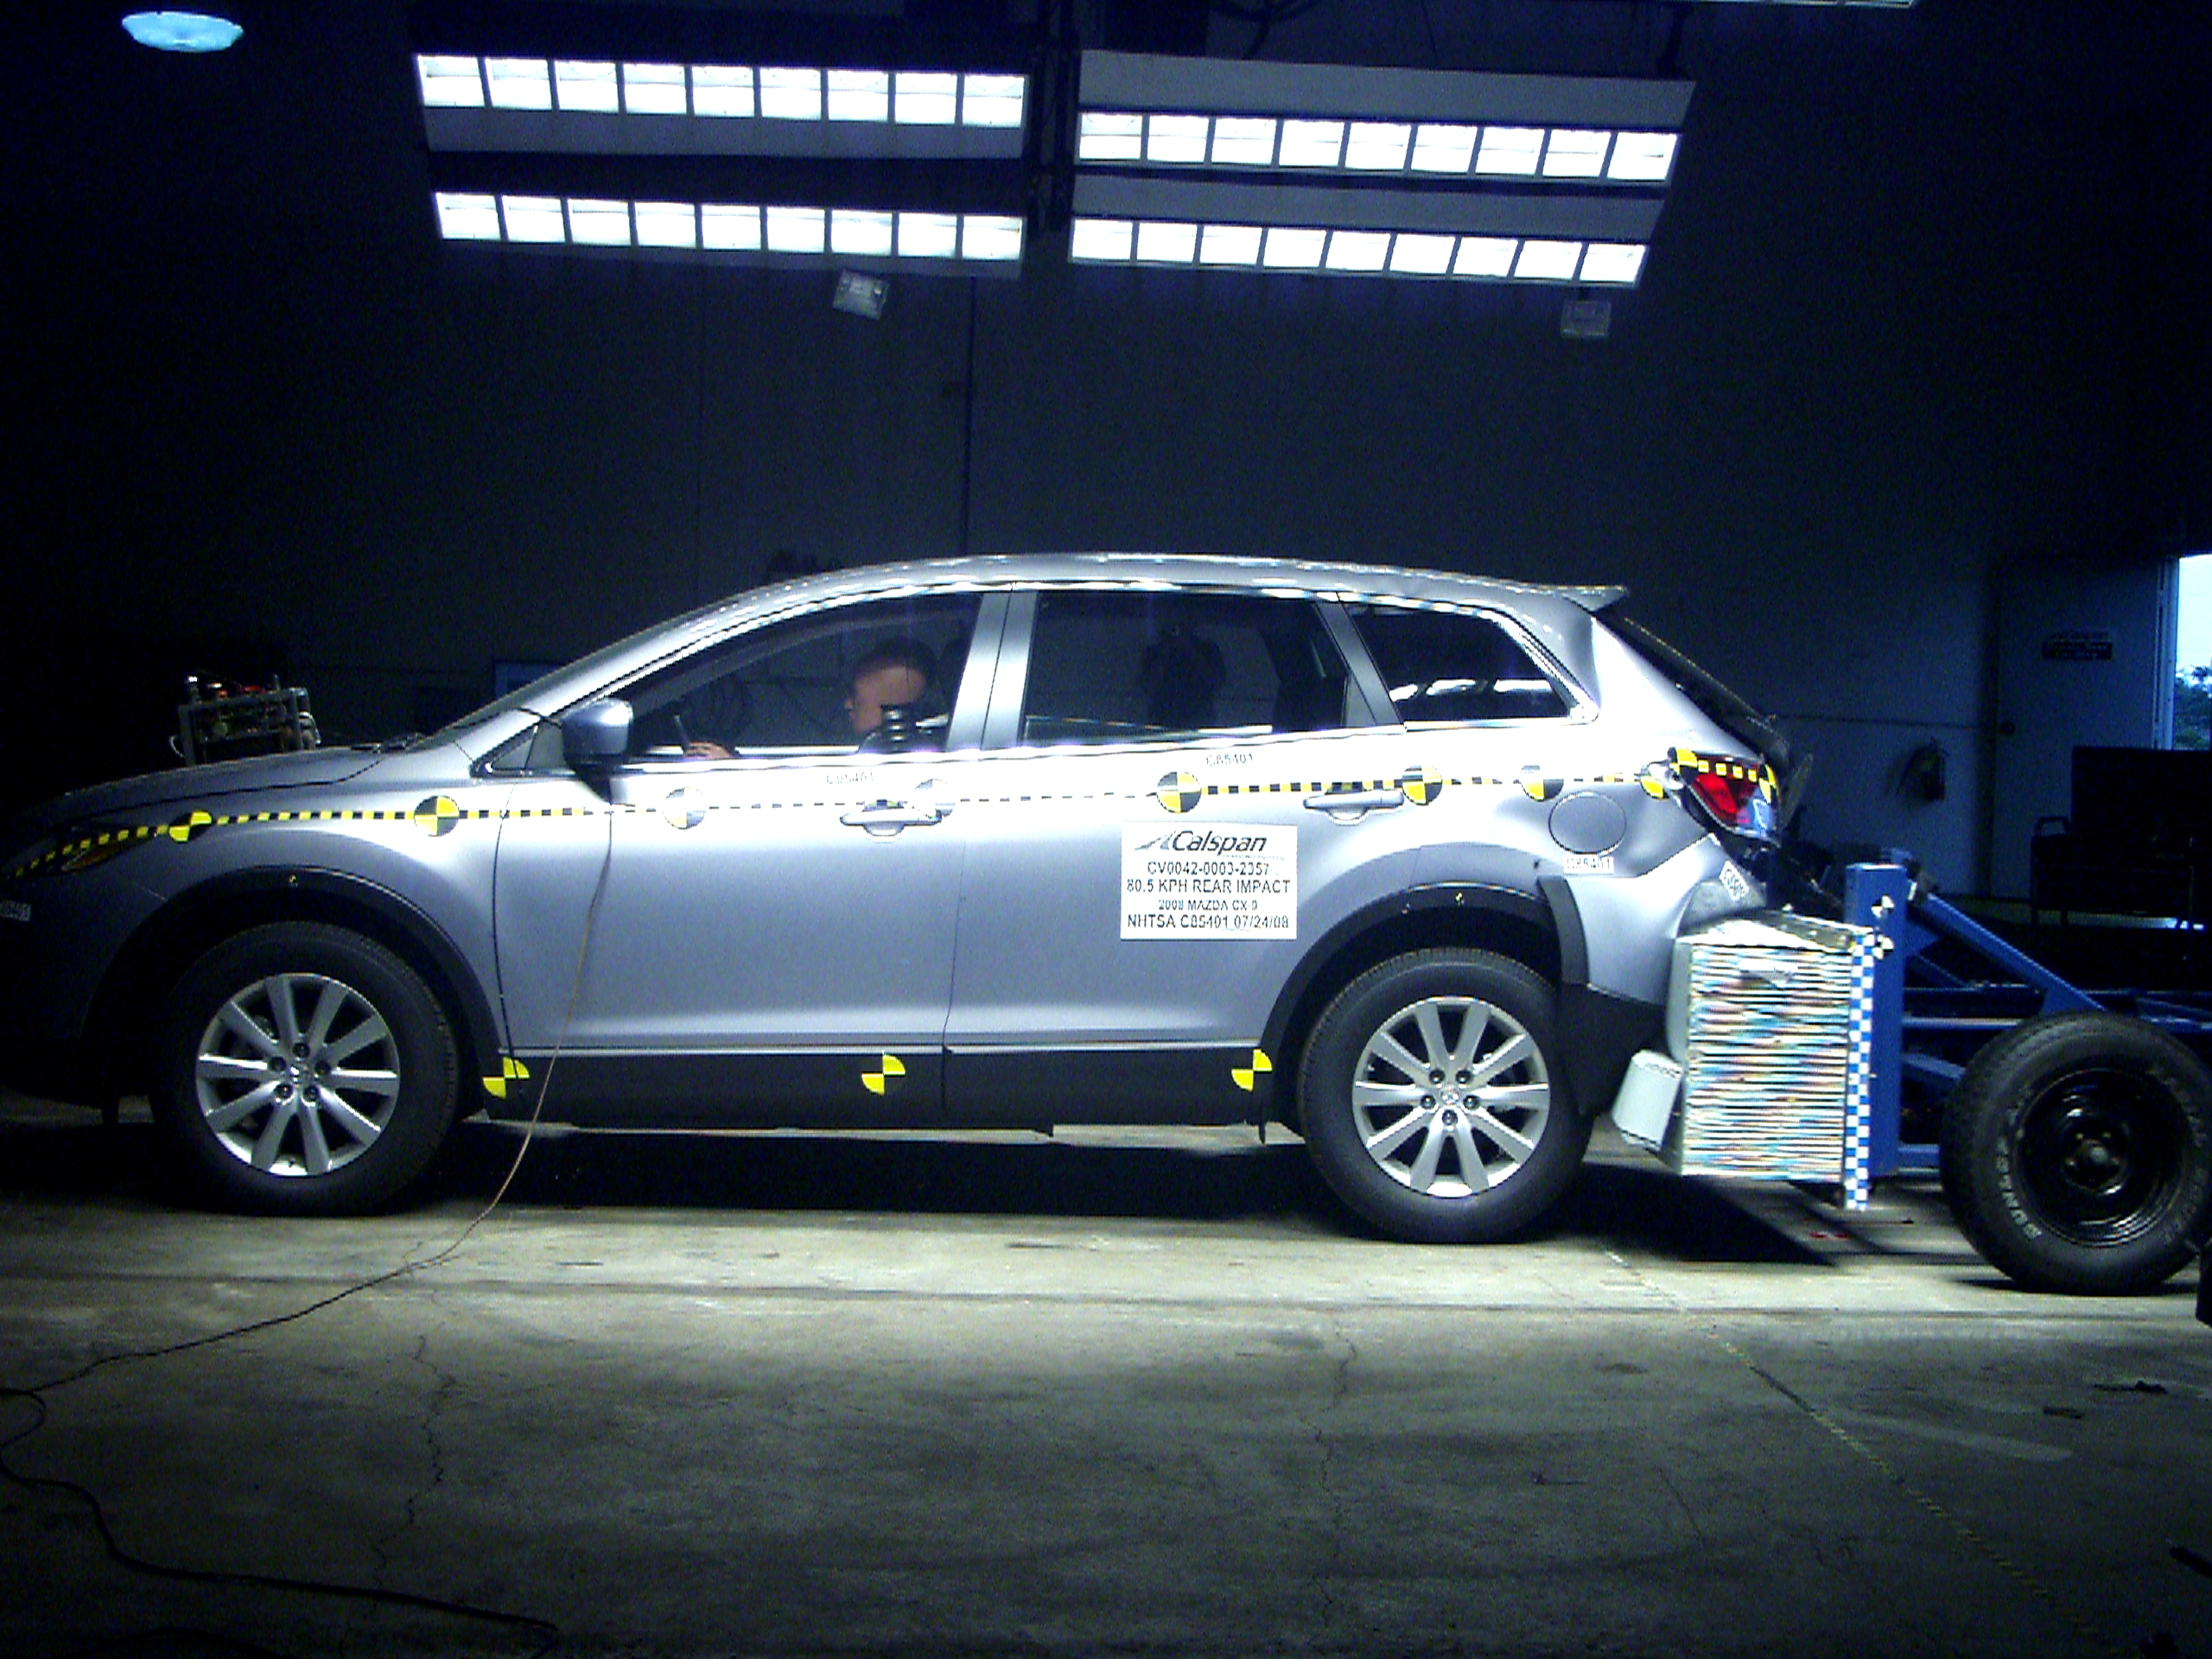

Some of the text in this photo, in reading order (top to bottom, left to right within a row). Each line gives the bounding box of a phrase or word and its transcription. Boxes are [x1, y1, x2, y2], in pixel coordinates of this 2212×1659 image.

[1172, 830, 1268, 856] Calspan
[1147, 861, 1269, 875] CV0042-0003-2357
[1127, 879, 1291, 893] 80.5 KPH REAR IMPACT
[1159, 899, 1184, 911] 2008
[1187, 899, 1229, 911] MAZDA
[1127, 914, 1289, 929] NHTSA C85401 07/24/08
